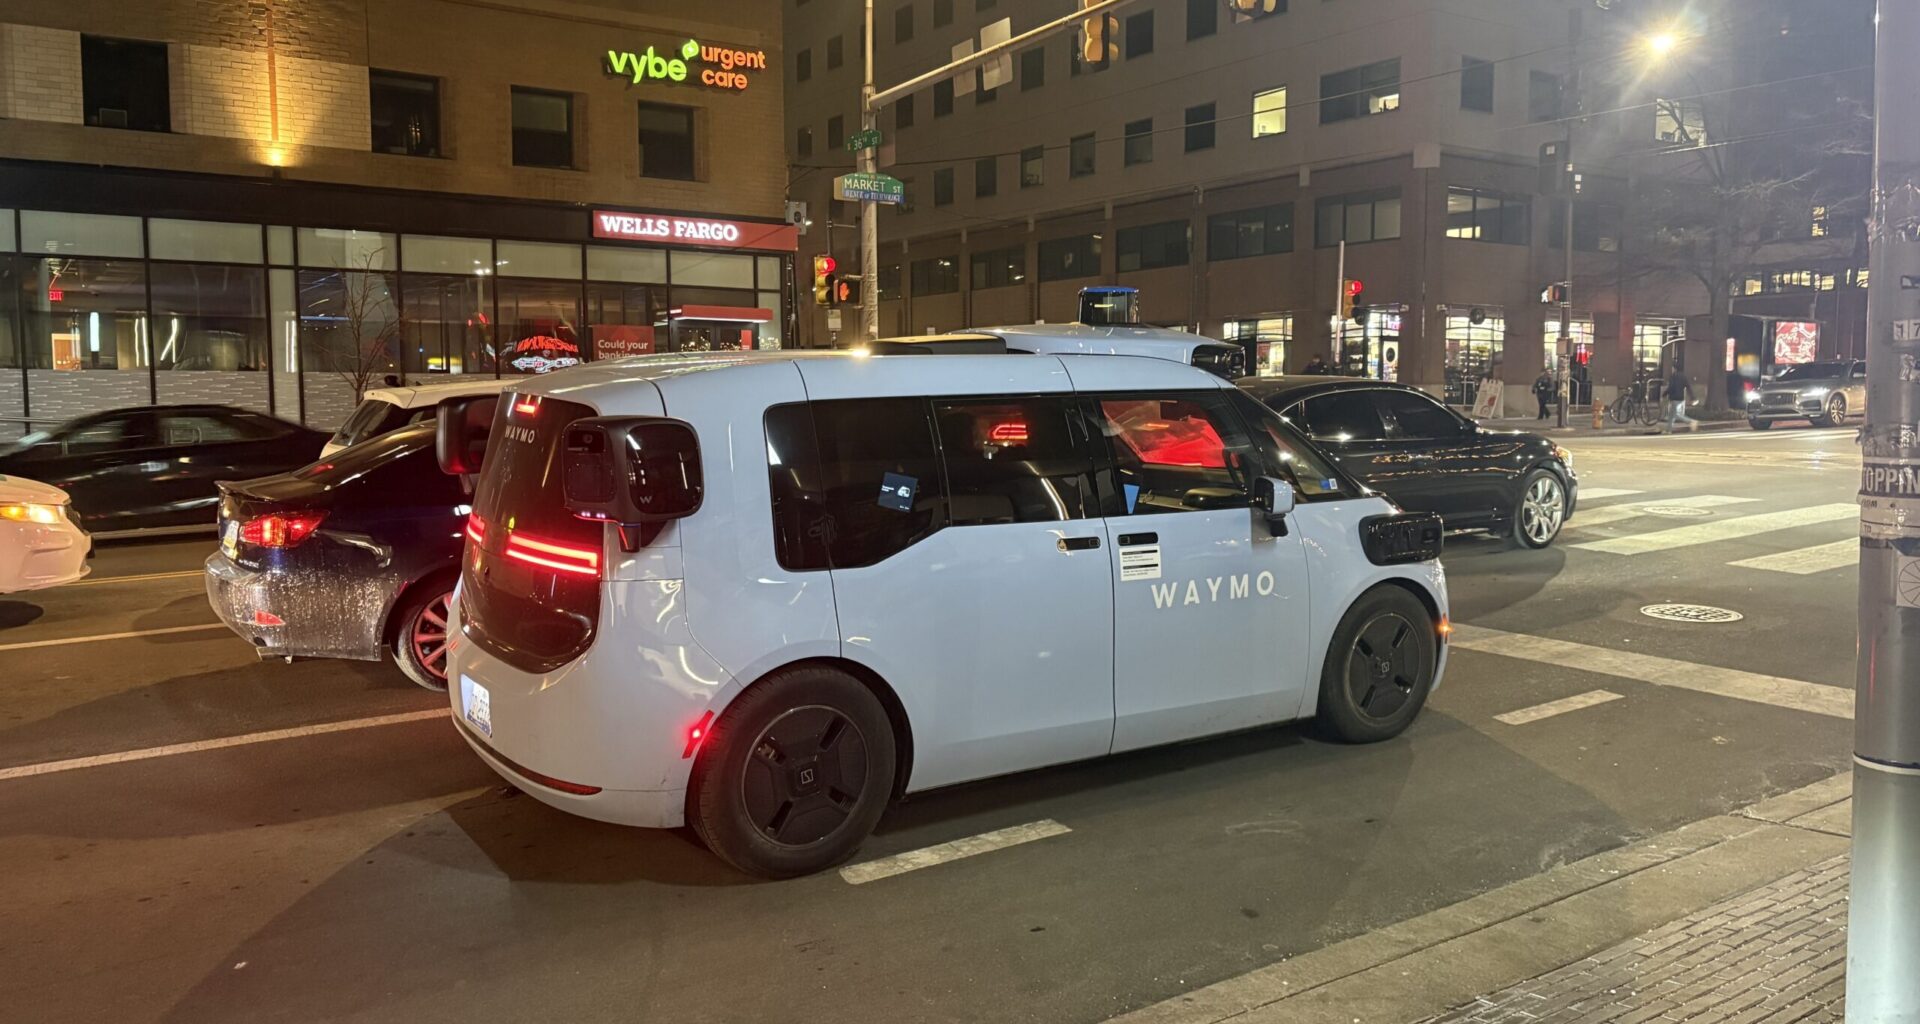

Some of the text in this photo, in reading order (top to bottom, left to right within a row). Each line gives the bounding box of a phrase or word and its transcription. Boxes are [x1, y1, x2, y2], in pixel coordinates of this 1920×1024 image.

[608, 46, 765, 84] vybe urgent
[702, 69, 748, 89] care
[844, 178, 885, 192] MARKET
[601, 215, 739, 241] WELLS FARGO
[598, 340, 648, 351] Could your
[505, 425, 535, 443] WAYMO
[1151, 571, 1274, 609] WAYMO
